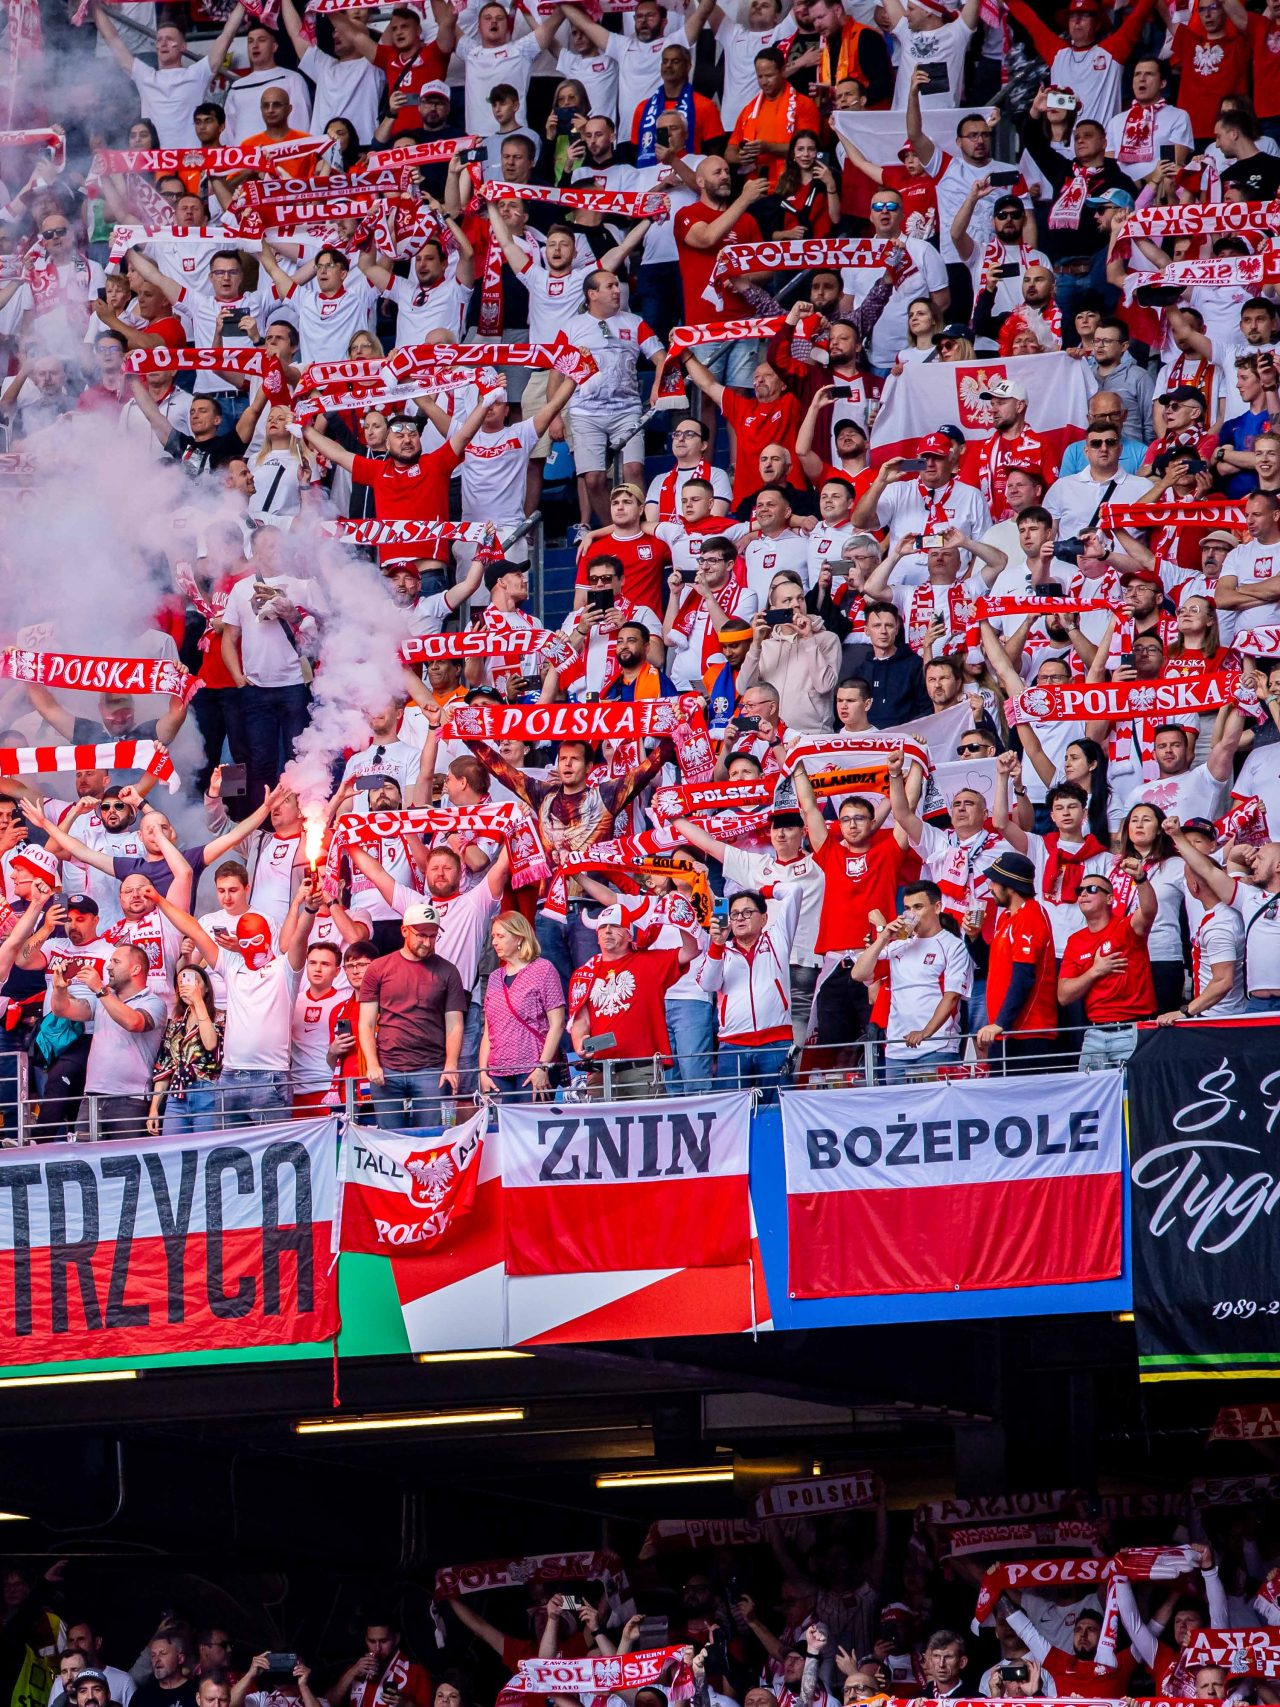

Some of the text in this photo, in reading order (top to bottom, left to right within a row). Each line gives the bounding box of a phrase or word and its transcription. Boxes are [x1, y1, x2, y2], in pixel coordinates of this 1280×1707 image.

[377, 138, 458, 166] POLSKA
[263, 171, 394, 197] POLSKA
[493, 186, 637, 215] POLSKA
[1135, 202, 1269, 235] POLSKA
[739, 241, 878, 271] POLSKA
[673, 316, 808, 348] OLSKA
[130, 347, 262, 376] POLSKA
[402, 633, 530, 661] POLSKA
[47, 656, 147, 691] POLSKA
[1168, 659, 1207, 669] POLSKA
[1062, 677, 1224, 716] POL SKA
[502, 707, 635, 736] POLSKA
[813, 738, 905, 753] POLSKA
[806, 771, 878, 788] OLANDIA
[692, 784, 769, 804] POLSKA
[345, 804, 522, 846] POLSKA
[390, 847, 399, 863] 9
[537, 1106, 718, 1183] ŻNIN
[805, 1110, 1100, 1170] BOŻEPOLE
[787, 1482, 871, 1508] POLSKA
[634, 1650, 667, 1661] WIERNI
[535, 1665, 593, 1685] POL
